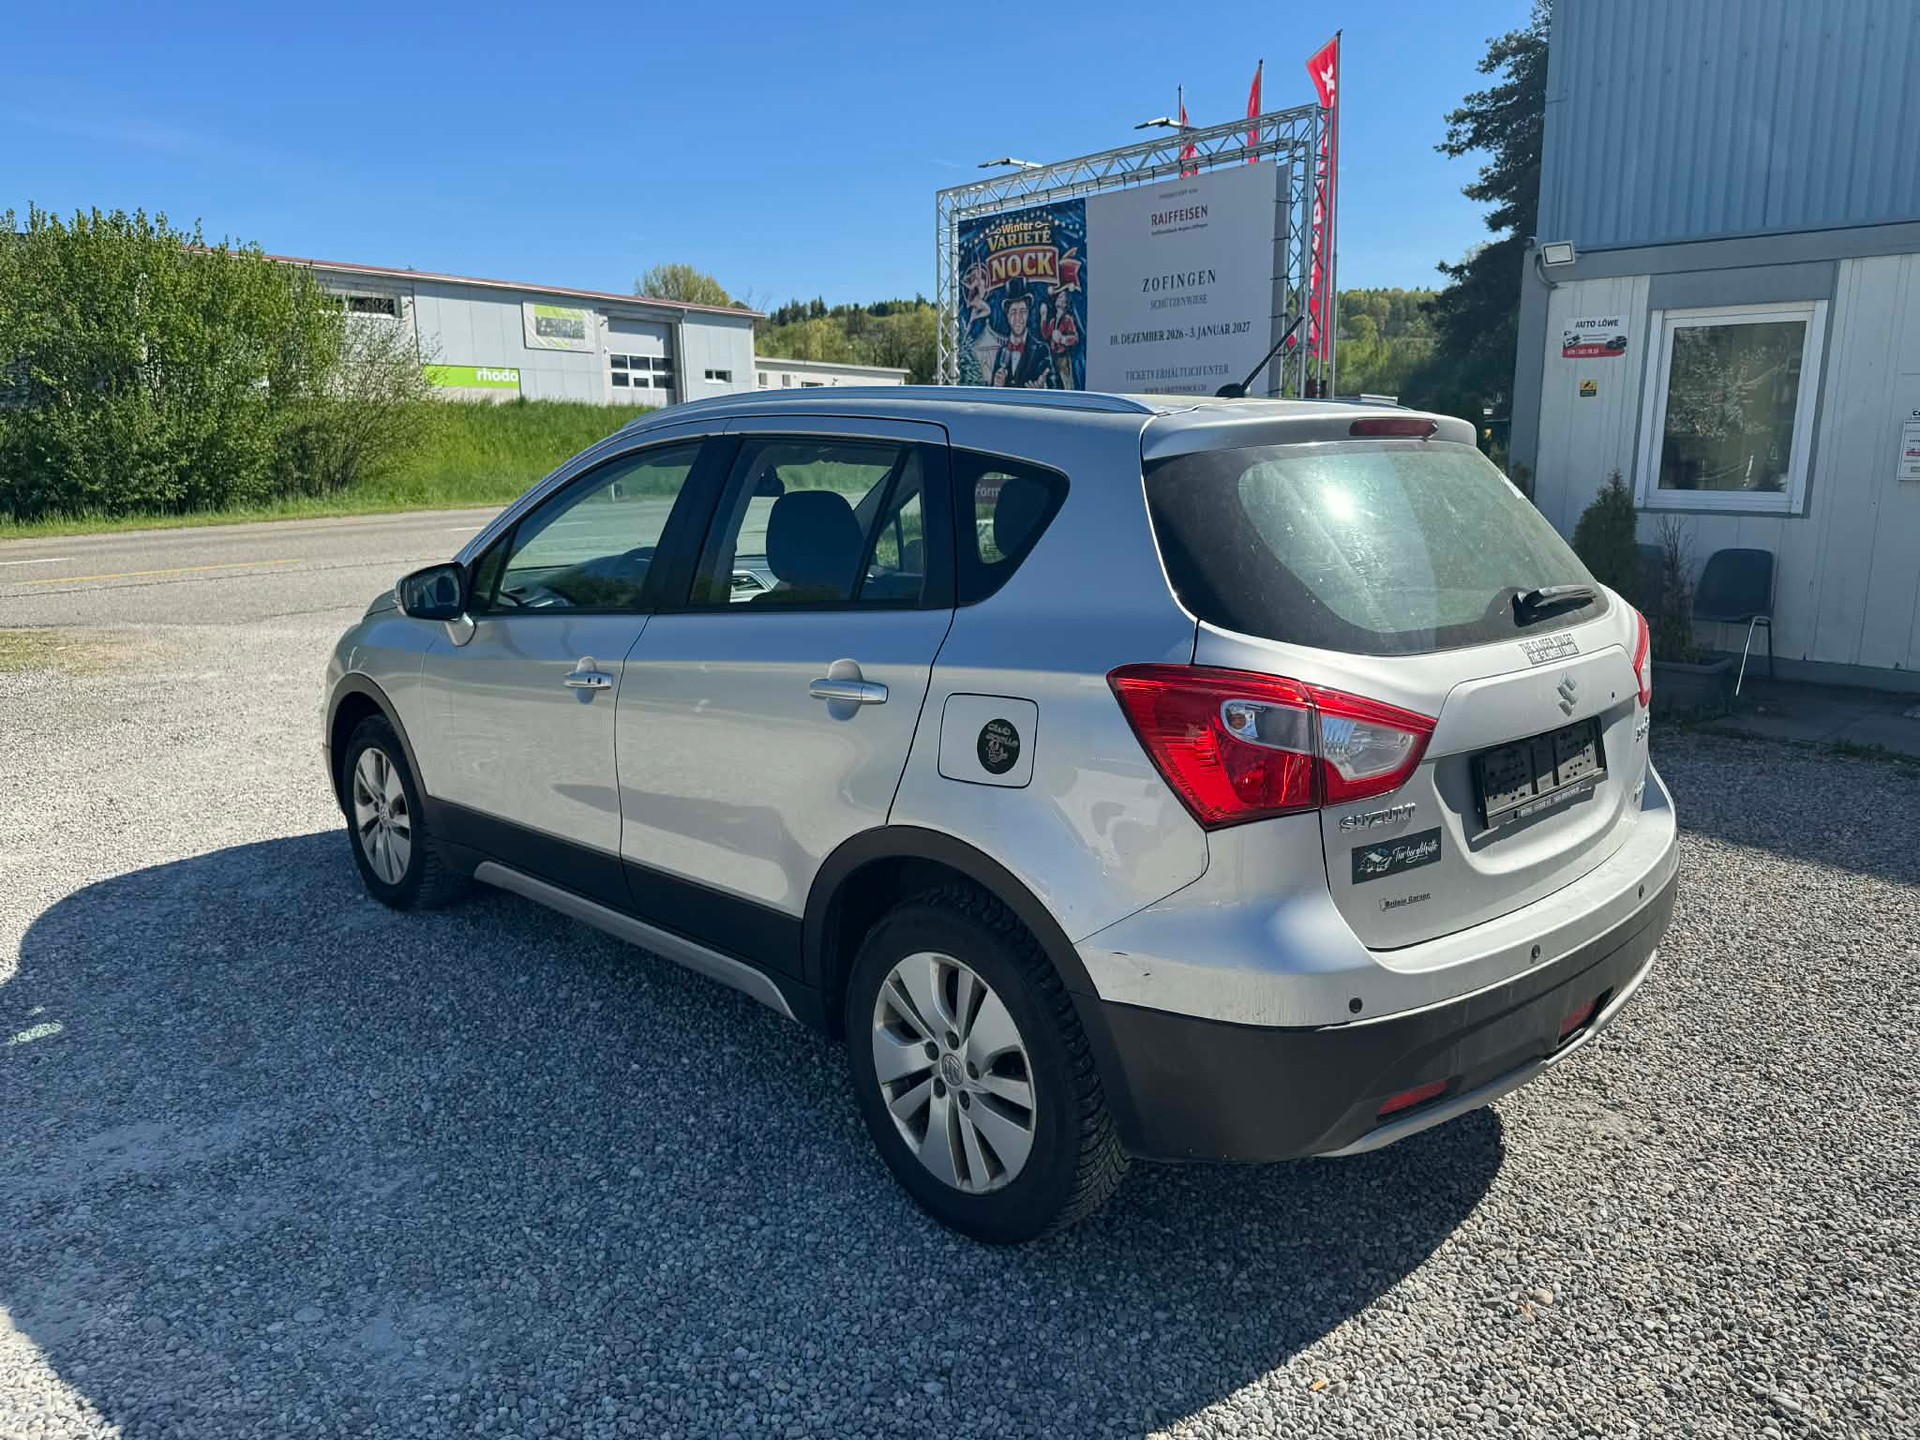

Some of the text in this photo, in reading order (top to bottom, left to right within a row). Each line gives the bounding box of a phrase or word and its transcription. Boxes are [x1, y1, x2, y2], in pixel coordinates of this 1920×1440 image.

[1151, 204, 1208, 226] RAIFFEISEN
[1001, 221, 1034, 235] Winter
[990, 252, 1054, 282] NOCK
[1142, 269, 1216, 293] ZOFINGEN
[1121, 329, 1165, 345] DEZEMBER
[1196, 322, 1231, 339] JANUAR
[1232, 321, 1251, 334] 2027
[1575, 318, 1619, 328] AUTO LÖWE
[1340, 802, 1416, 833] SUZUKI
